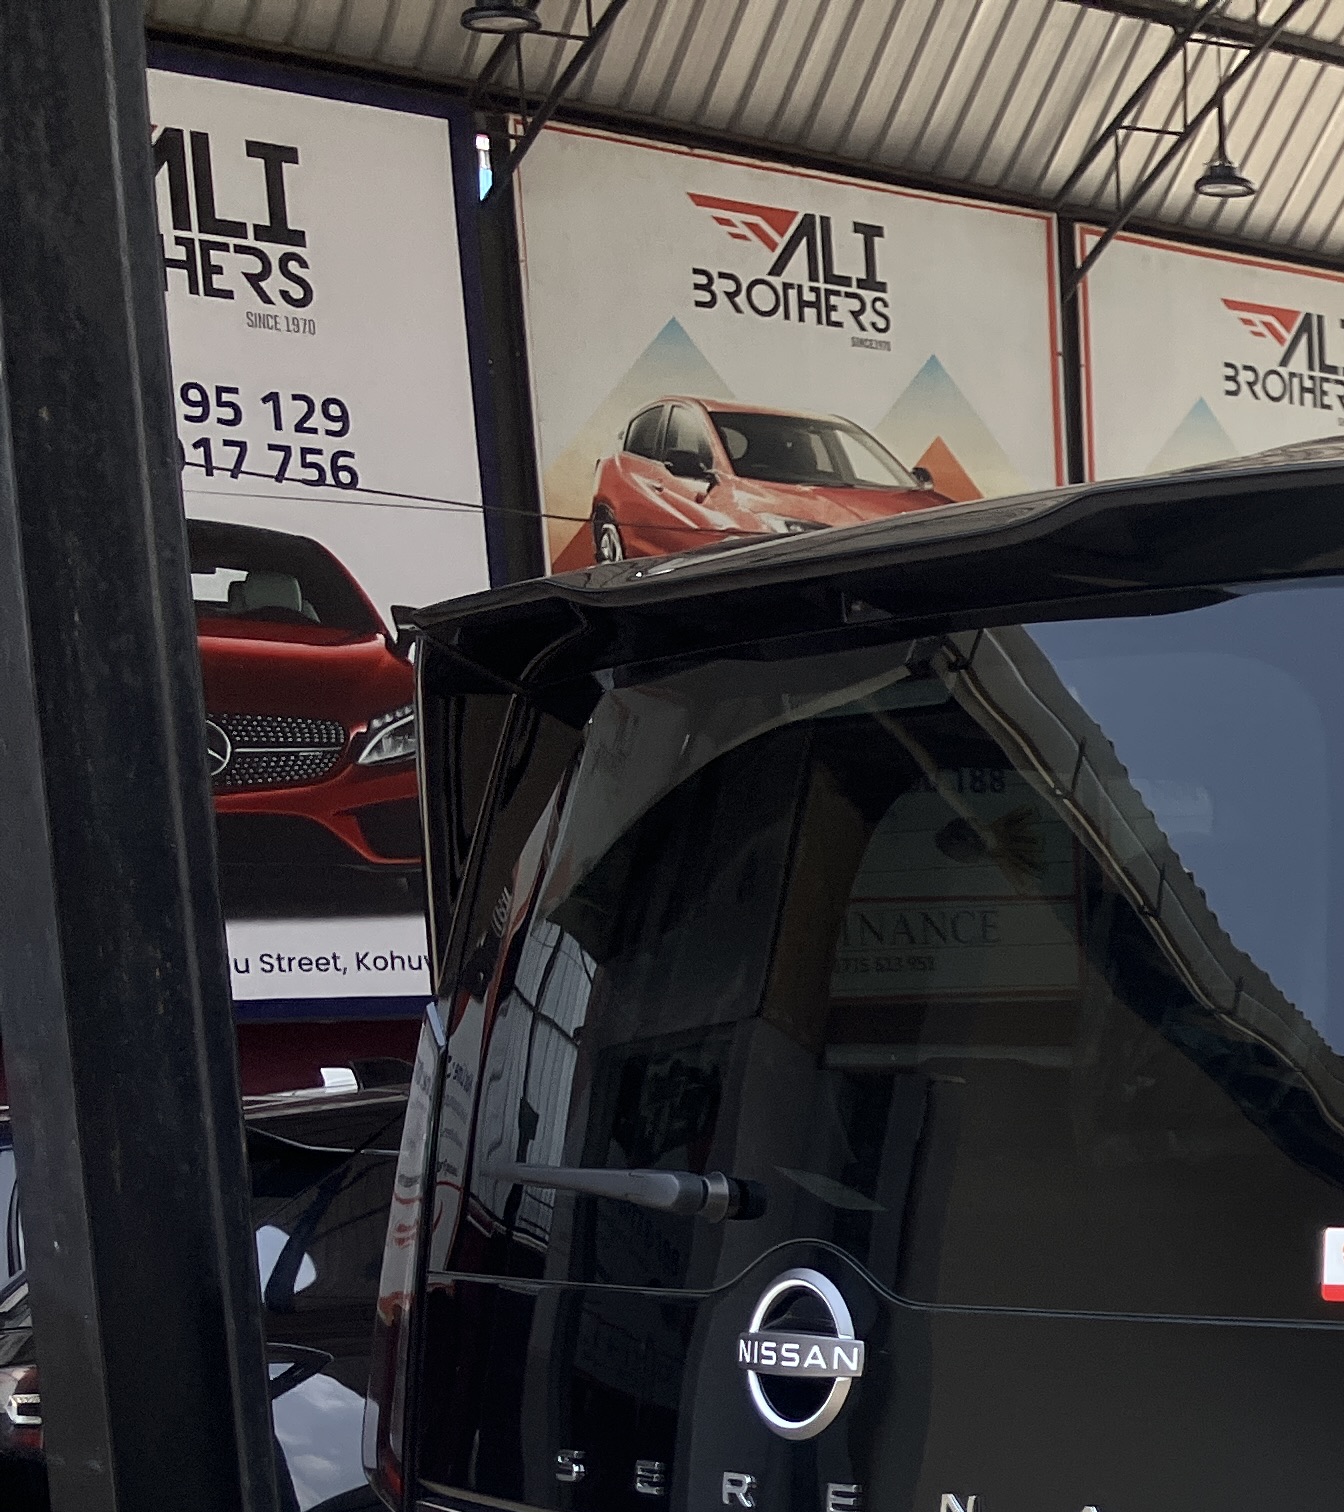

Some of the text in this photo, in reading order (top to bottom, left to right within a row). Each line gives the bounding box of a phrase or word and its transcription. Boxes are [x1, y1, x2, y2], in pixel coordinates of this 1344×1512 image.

[766, 213, 888, 293] ALI
[246, 311, 316, 336] SINCE 1970
[692, 267, 891, 334] BROTHERS
[180, 382, 350, 438] 95 129
[266, 443, 360, 490] 756
[233, 958, 250, 974] u
[259, 953, 348, 975] Street,
[738, 1338, 861, 1372] NISSAN
